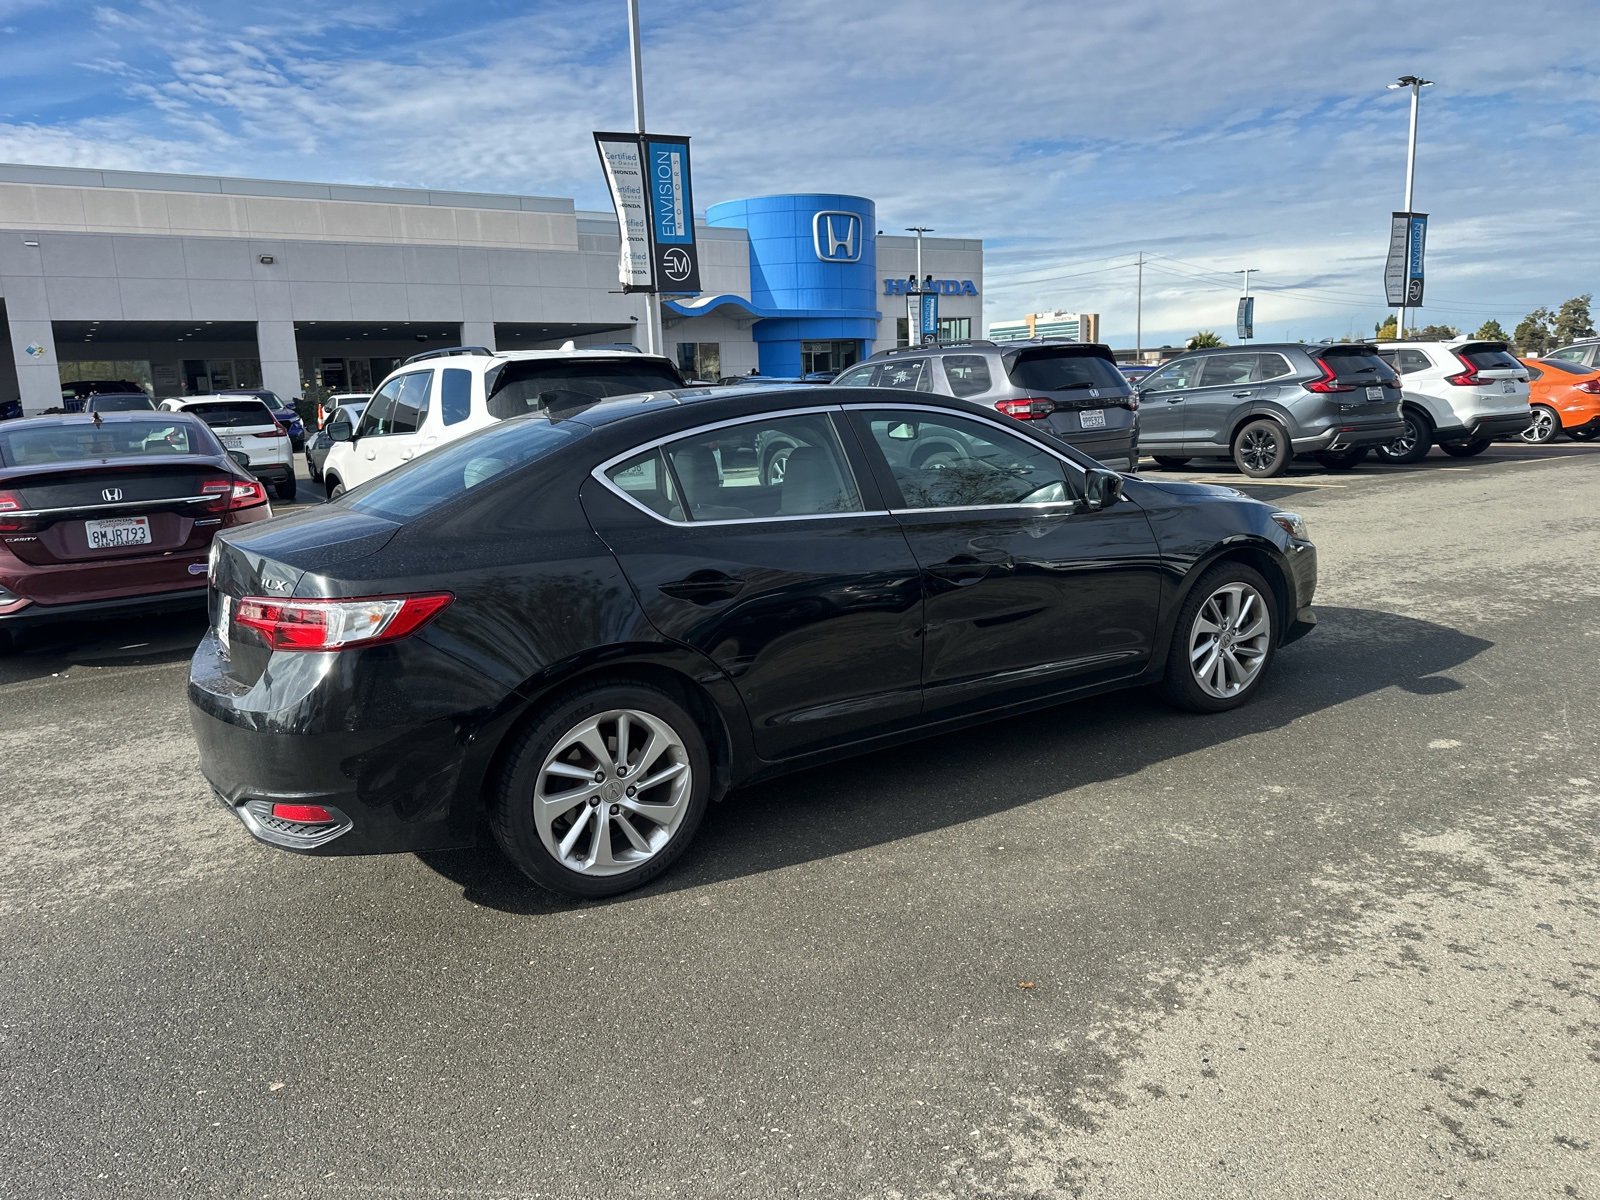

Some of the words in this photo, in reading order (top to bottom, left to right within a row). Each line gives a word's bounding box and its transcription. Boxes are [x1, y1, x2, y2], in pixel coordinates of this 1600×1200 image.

[656, 151, 676, 236] ENVISION
[673, 160, 683, 230] MOTORS
[1411, 222, 1421, 274] ENVISION
[92, 526, 147, 544] 8MJR793
